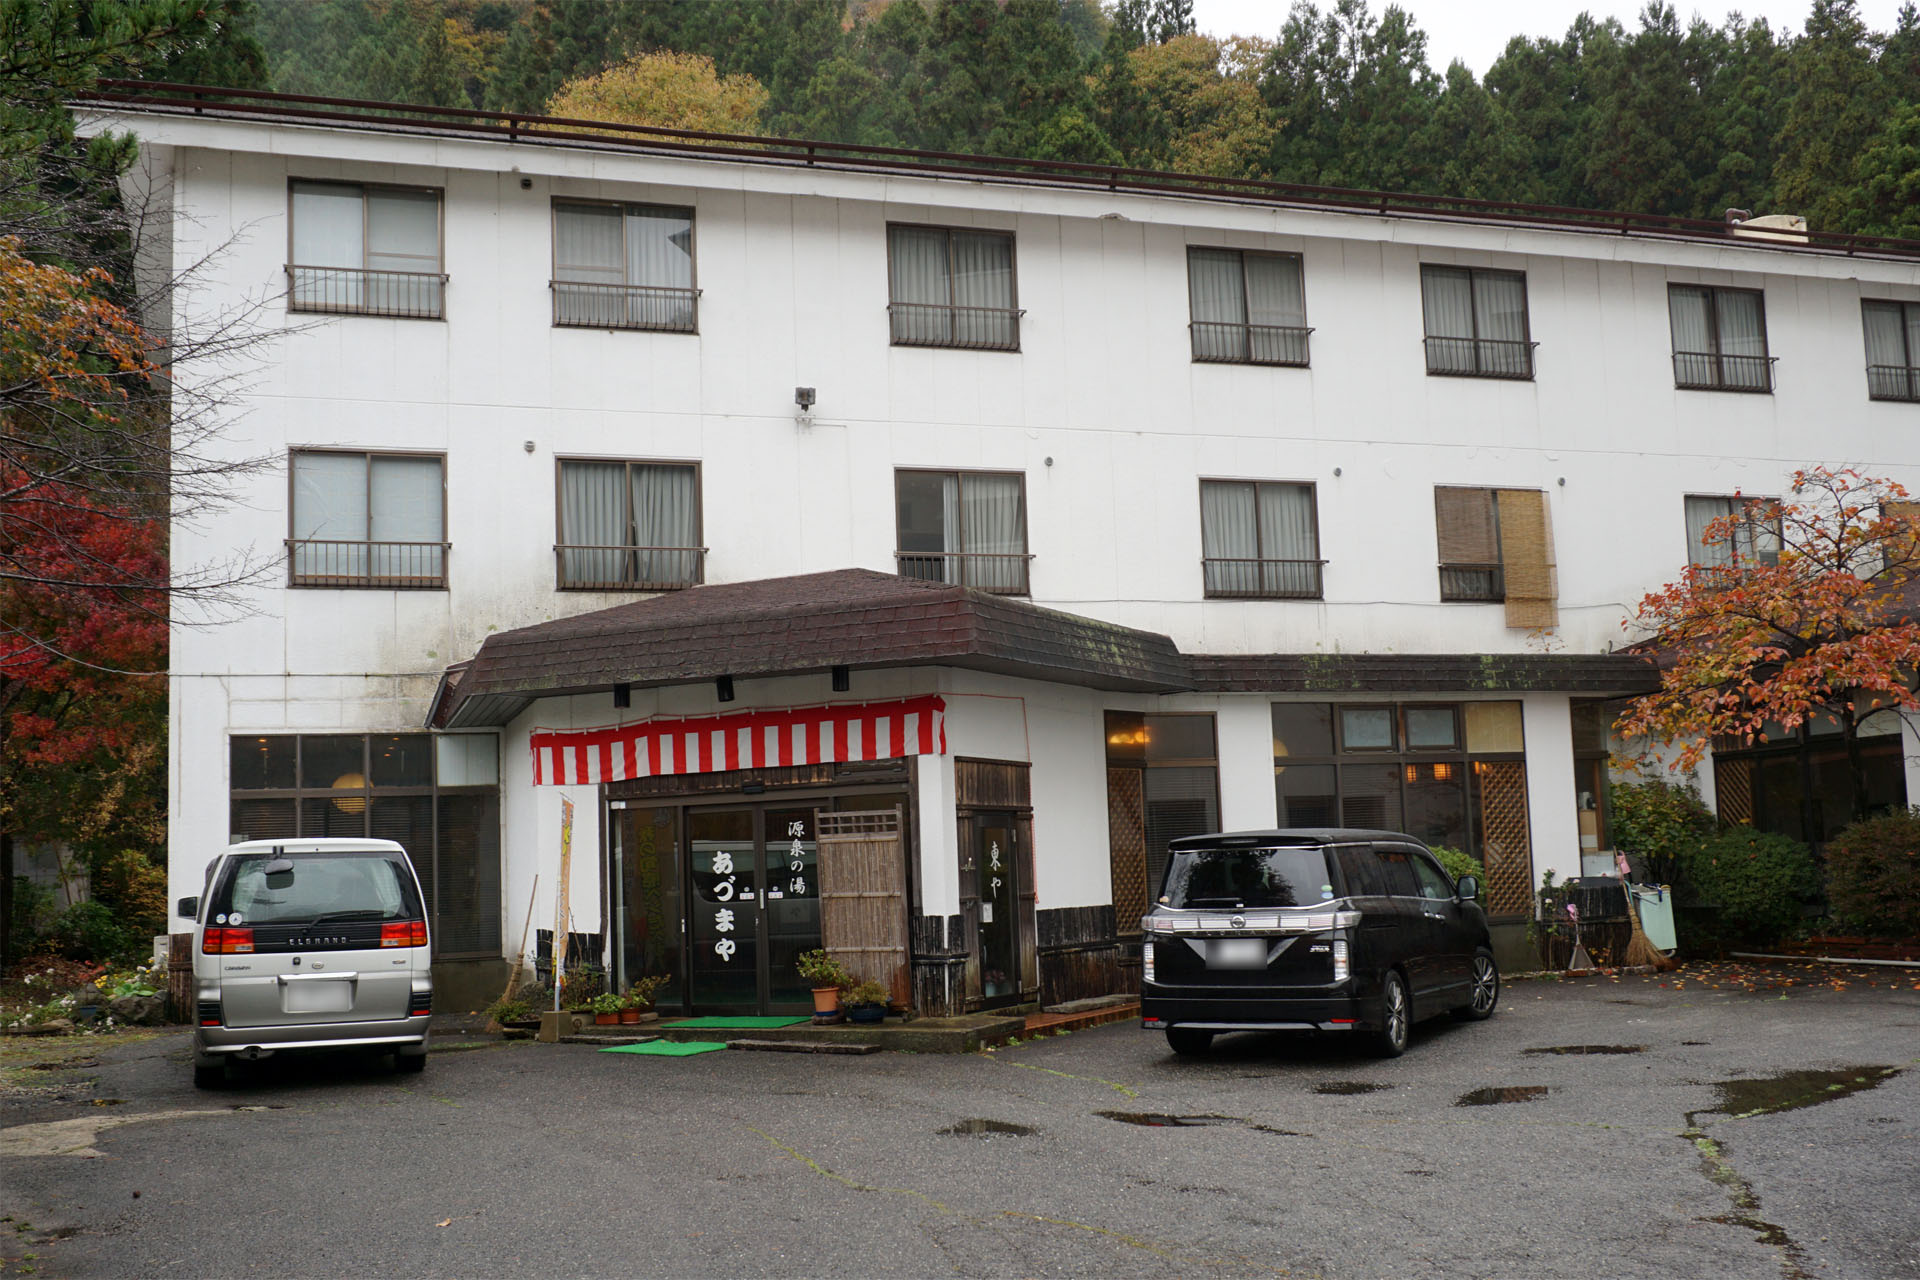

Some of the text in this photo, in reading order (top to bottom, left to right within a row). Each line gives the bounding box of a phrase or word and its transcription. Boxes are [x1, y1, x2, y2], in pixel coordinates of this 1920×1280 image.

[787, 820, 807, 895] 源泉の湯
[289, 936, 348, 945] ELGRAND
[711, 850, 737, 962] あづまや
